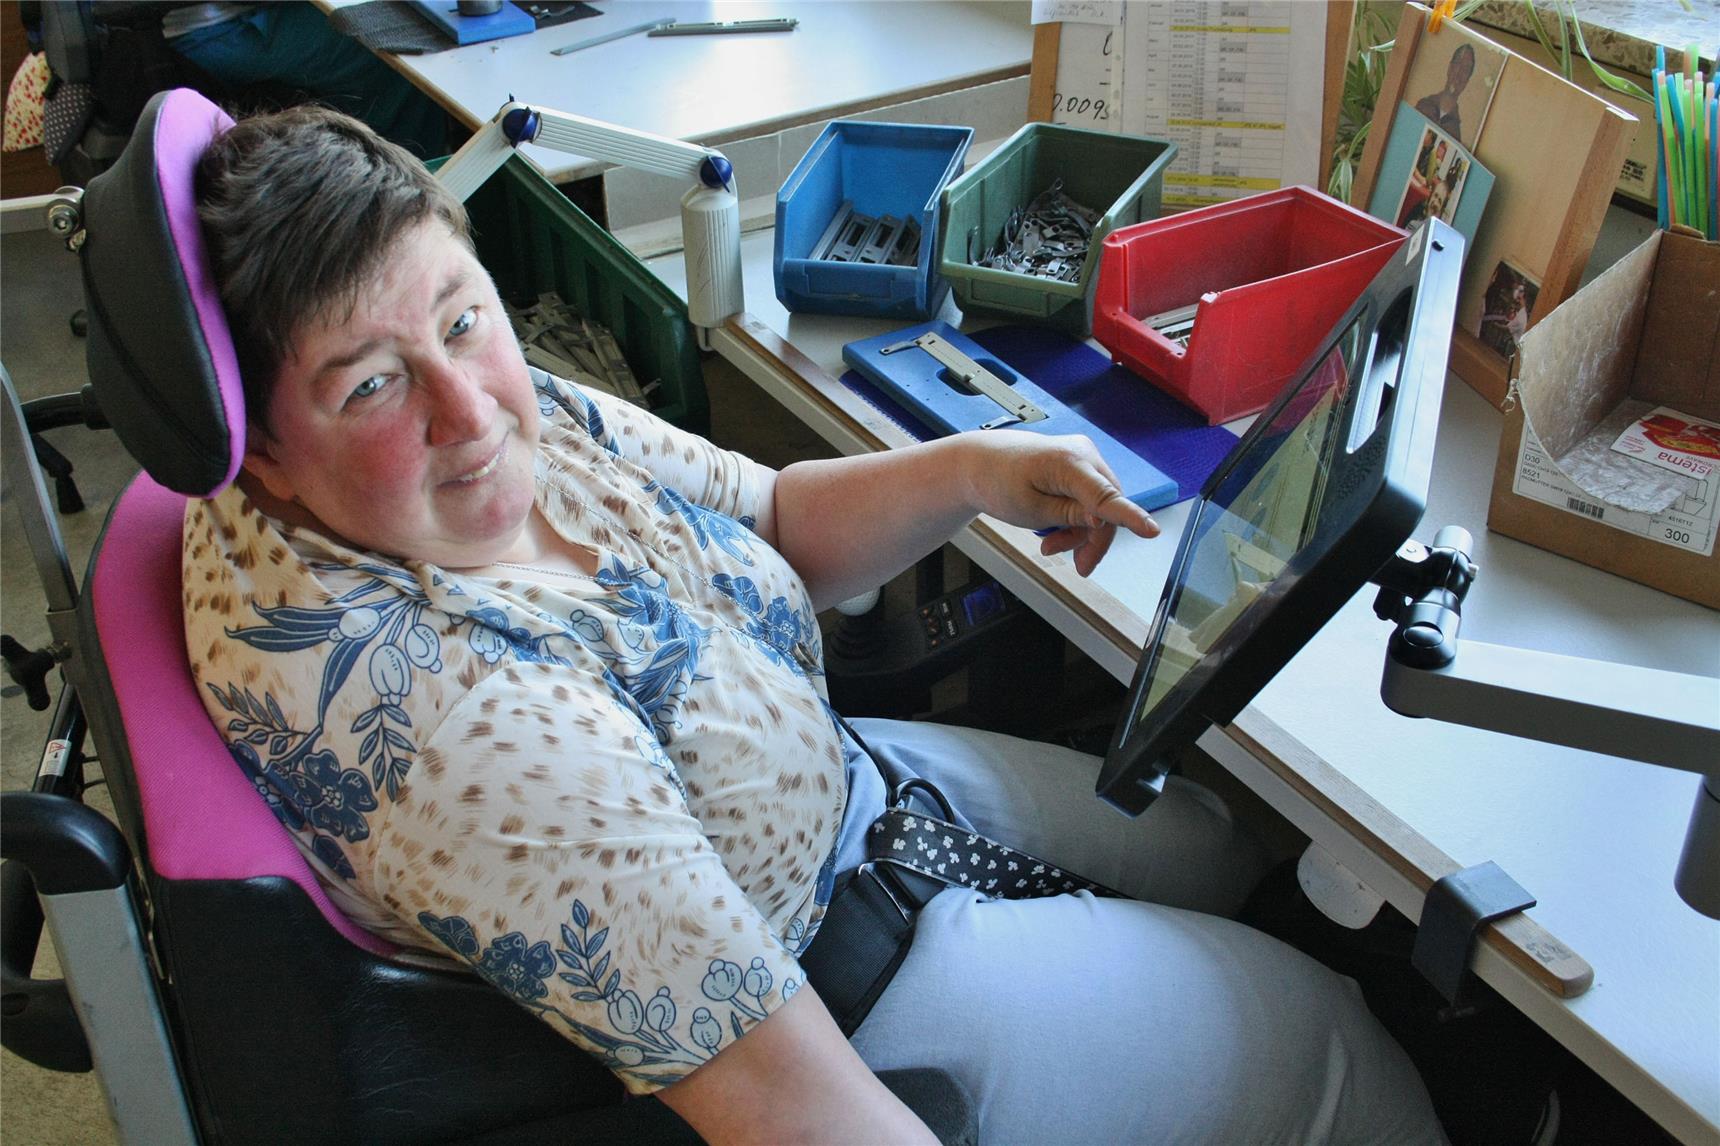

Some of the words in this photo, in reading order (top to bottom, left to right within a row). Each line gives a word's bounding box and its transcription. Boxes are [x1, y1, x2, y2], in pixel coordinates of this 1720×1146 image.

[1525, 453, 1540, 464] D30
[1522, 468, 1540, 480] 8521
[1664, 528, 1690, 544] 300
